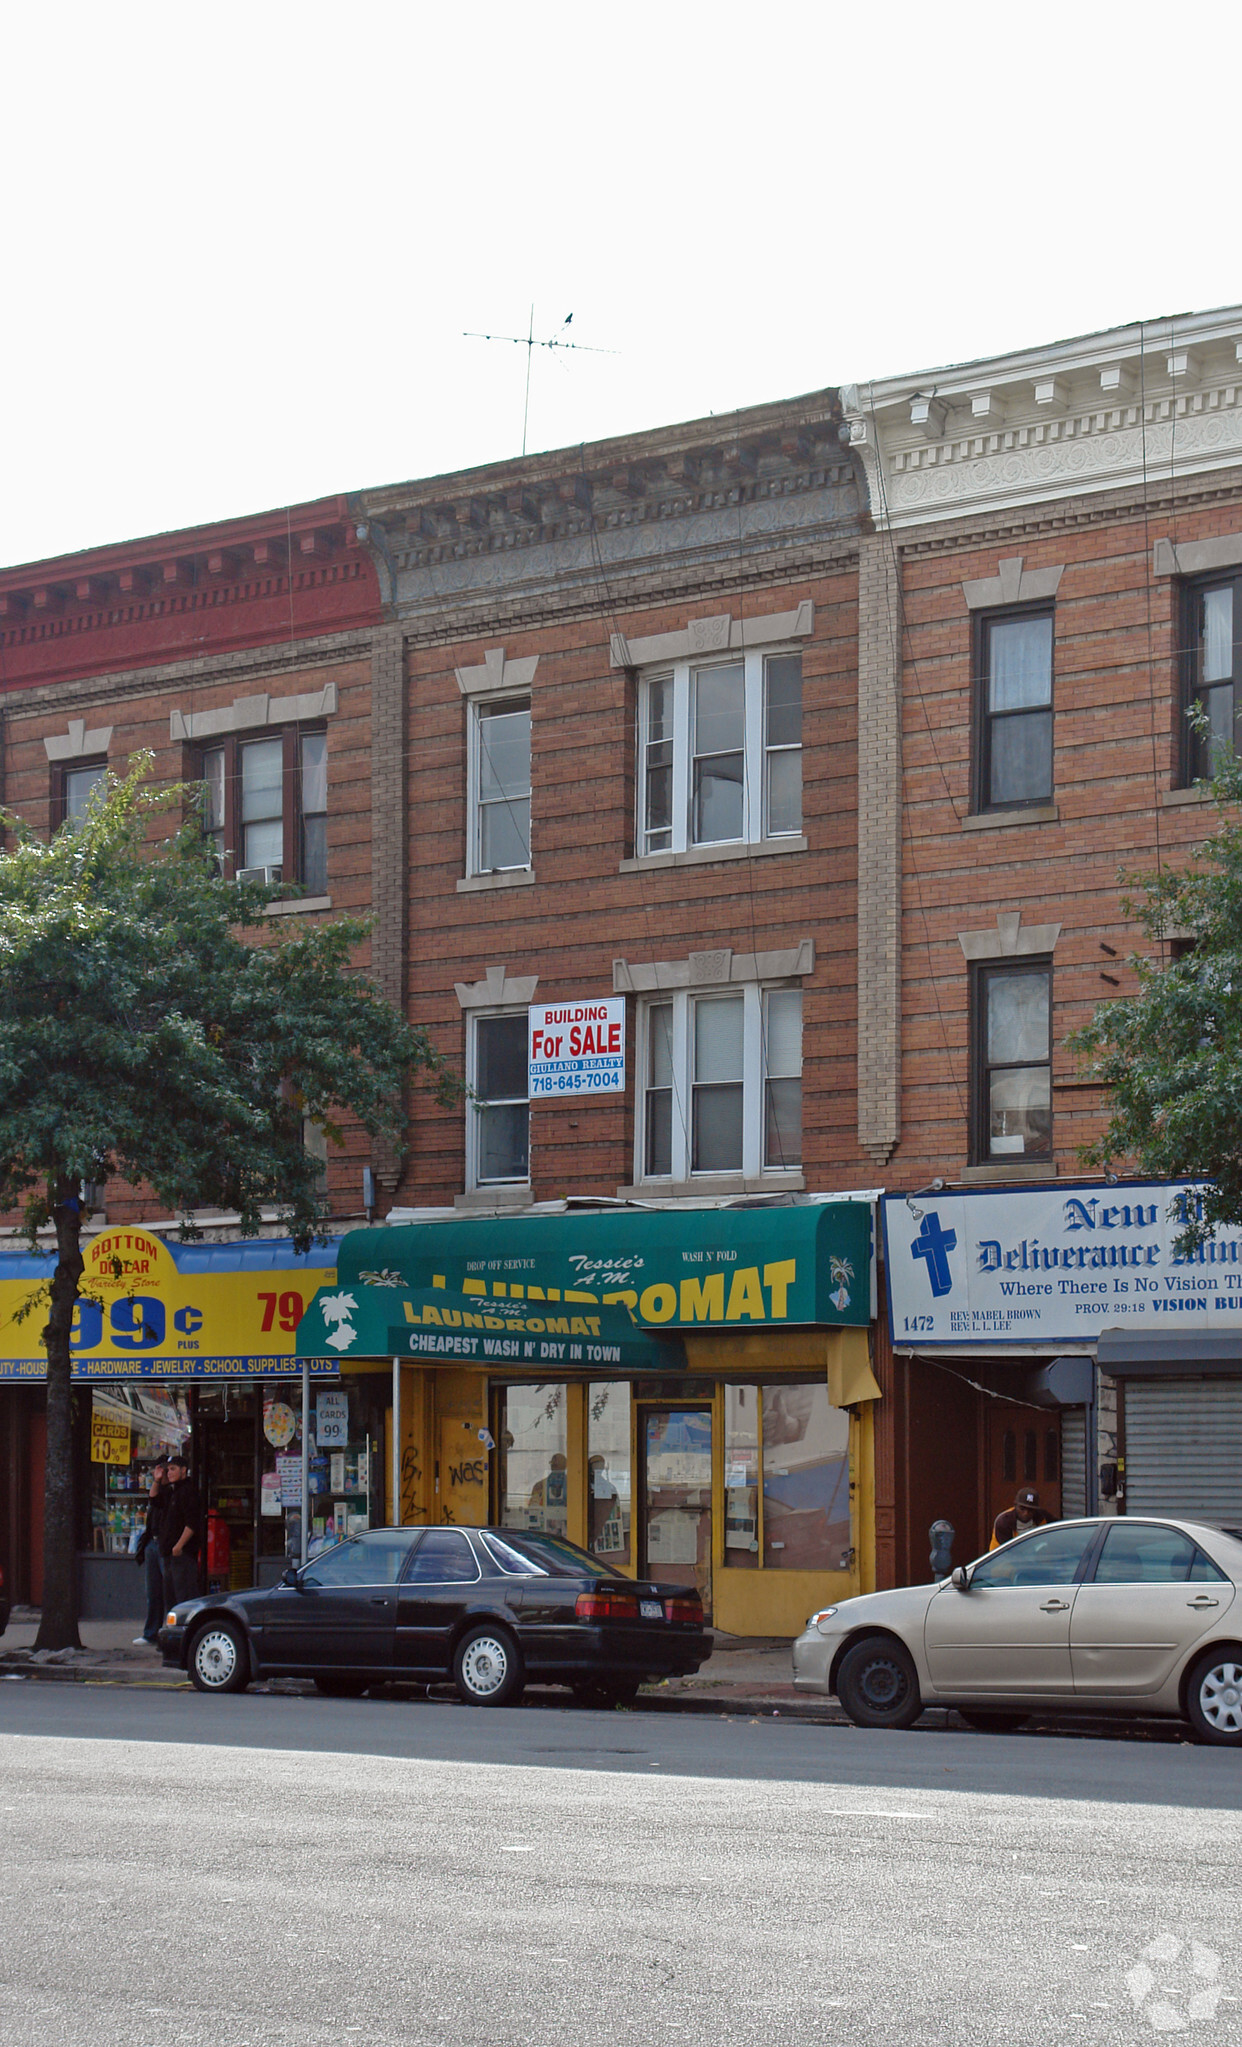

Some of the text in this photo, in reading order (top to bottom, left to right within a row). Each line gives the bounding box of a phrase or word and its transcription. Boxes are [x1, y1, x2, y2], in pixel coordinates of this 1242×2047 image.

[545, 1006, 608, 1025] BUILDING
[532, 1023, 621, 1060] For SALE
[530, 1057, 623, 1074] GIULIANO REALTY
[532, 1072, 620, 1092] 718-645-7004
[1064, 1197, 1159, 1233] New
[91, 1235, 158, 1263] BOTTOM
[682, 1252, 703, 1262] WASH
[717, 1250, 738, 1261] FOLD
[975, 1238, 1161, 1274] Deliverance
[100, 1259, 150, 1275] DOLAR
[466, 1258, 536, 1271] DROP OFF SERVICE
[568, 1254, 645, 1272] Tessie's
[88, 1277, 161, 1290] Variety Store
[573, 1271, 635, 1287] A.M.
[999, 1281, 1053, 1296] Where
[1057, 1279, 1108, 1295] There
[1112, 1278, 1129, 1293] Is
[1134, 1278, 1159, 1292] No
[1164, 1275, 1218, 1291] Vision
[469, 1297, 529, 1310] Tessie's
[1075, 1303, 1110, 1314] PROV.
[1113, 1302, 1146, 1313] 29:18
[1152, 1298, 1207, 1312] VISION
[402, 1301, 602, 1337] LAUNDROMAT
[972, 1310, 1005, 1320] MABEL
[1007, 1309, 1041, 1320] BROWN
[904, 1315, 934, 1332] 1472
[972, 1321, 981, 1331] L.
[983, 1321, 992, 1331] L.
[993, 1320, 1012, 1331] LEE
[177, 1340, 200, 1350] PLUS
[409, 1333, 479, 1354] CHEAPEST
[483, 1338, 520, 1357] WASH
[540, 1342, 566, 1360] DRY
[569, 1344, 583, 1360] IN
[586, 1344, 622, 1362] TOWN
[87, 1361, 143, 1374] HARDWARE
[150, 1360, 197, 1373] JEWELRY
[203, 1359, 246, 1373] SCHOOL
[247, 1358, 297, 1372] SUPPLIES
[310, 1358, 333, 1370] OYS
[325, 1396, 341, 1406] ALL
[319, 1410, 346, 1419] CARDS
[94, 1425, 129, 1438] CARDS
